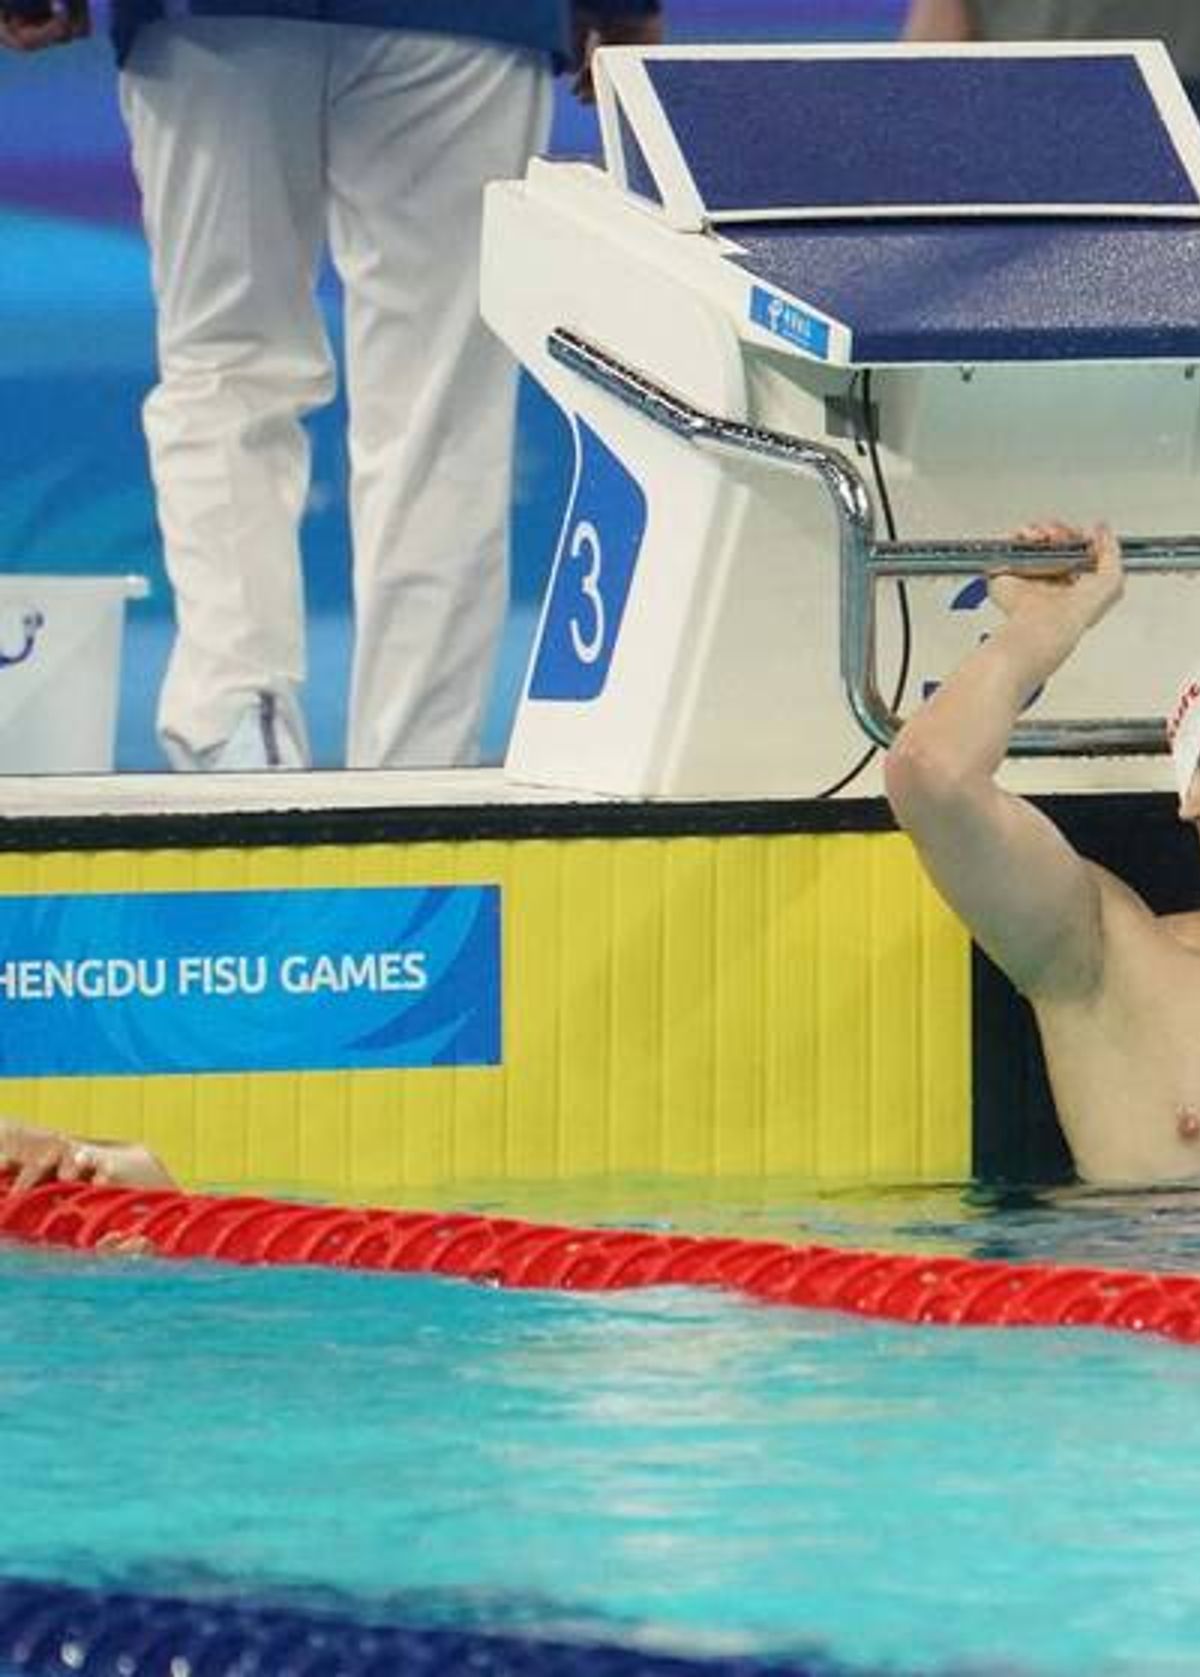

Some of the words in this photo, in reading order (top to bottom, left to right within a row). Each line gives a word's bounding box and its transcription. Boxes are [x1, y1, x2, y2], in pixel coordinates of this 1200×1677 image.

[568, 520, 604, 664] 3
[178, 955, 266, 995] FISU
[279, 952, 427, 993] GAMES
